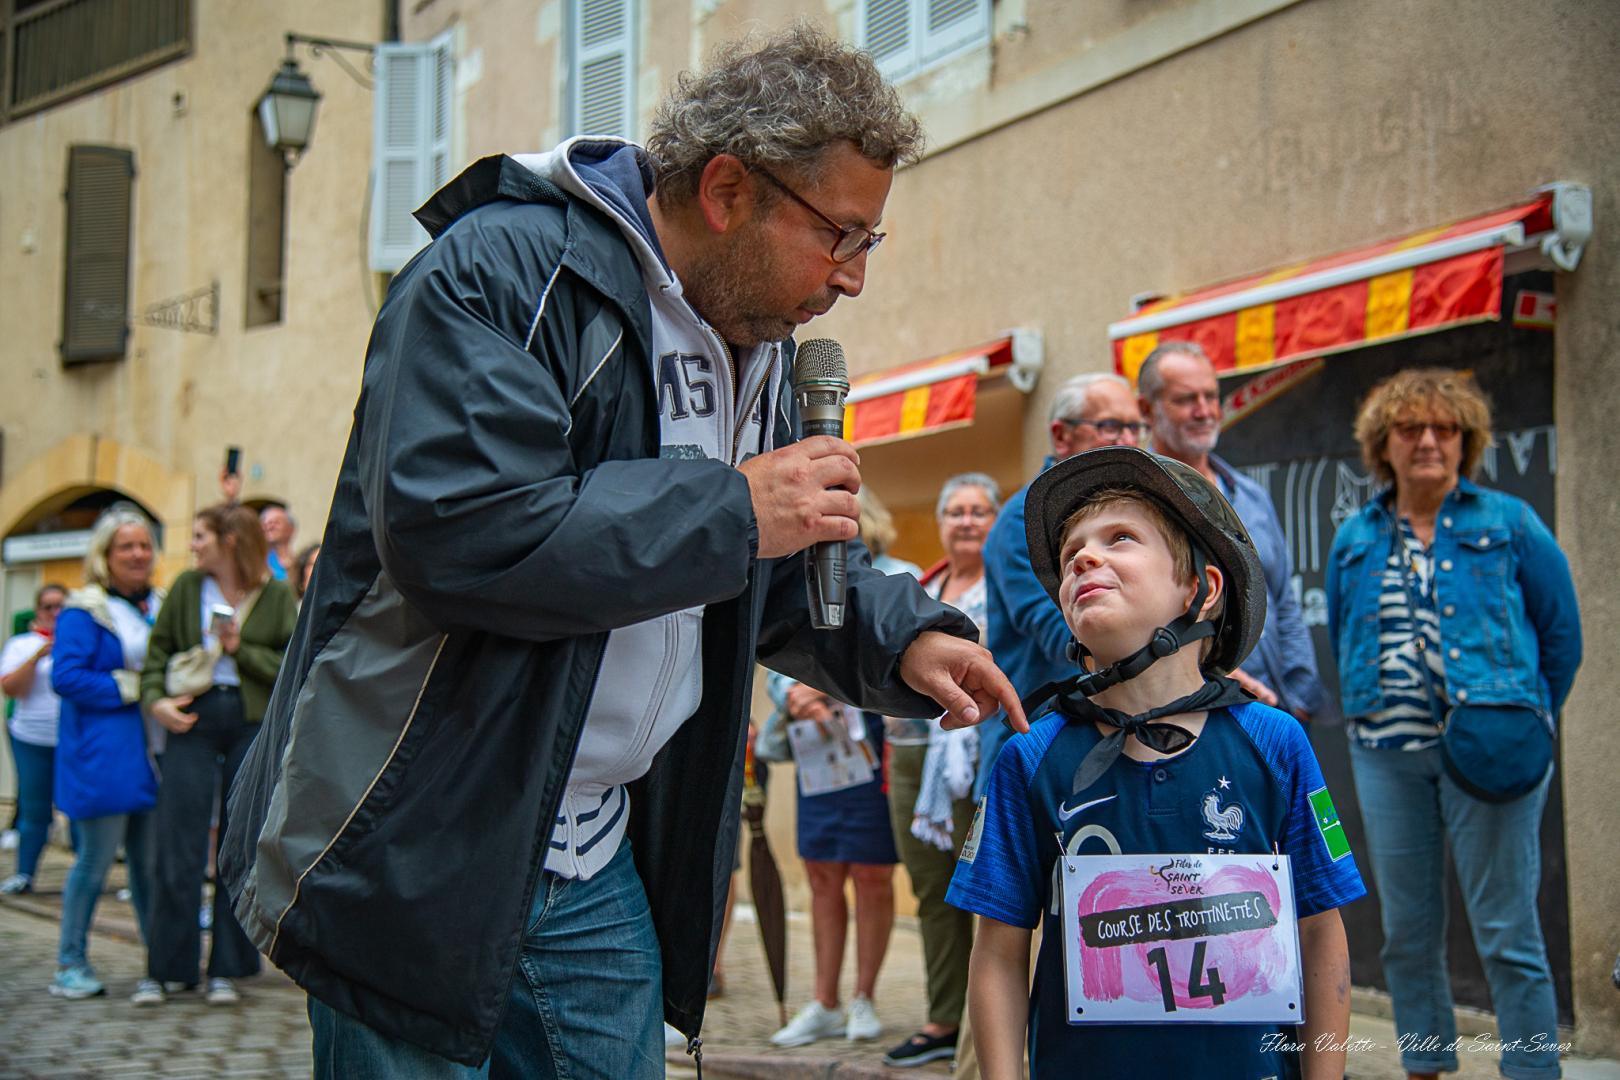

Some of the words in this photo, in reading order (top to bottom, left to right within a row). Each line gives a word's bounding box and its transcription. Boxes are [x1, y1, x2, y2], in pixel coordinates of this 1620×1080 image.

[1167, 872, 1201, 882] SAINT
[1170, 884, 1205, 895] SEVER
[1097, 915, 1143, 940] COURSE
[1148, 909, 1172, 933] DES
[1175, 896, 1261, 929] TROTTINETTES
[1146, 940, 1227, 1013] 14
